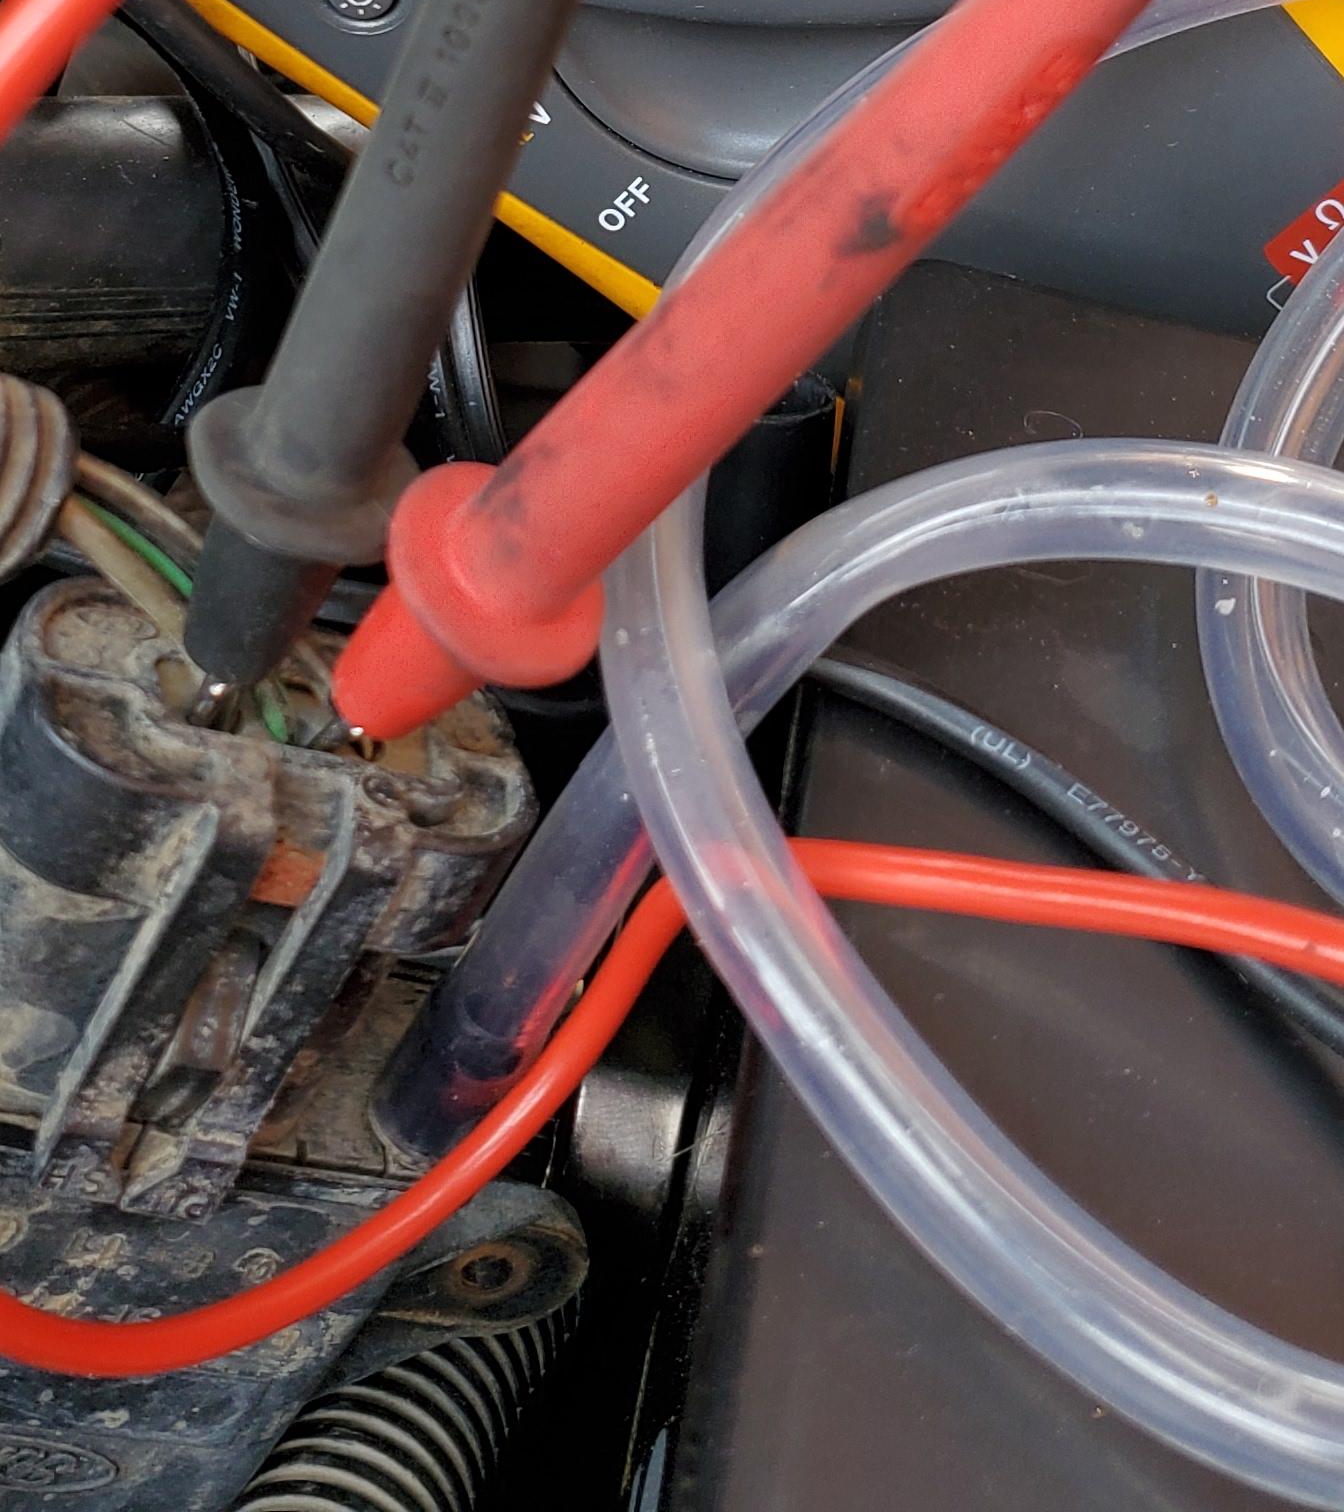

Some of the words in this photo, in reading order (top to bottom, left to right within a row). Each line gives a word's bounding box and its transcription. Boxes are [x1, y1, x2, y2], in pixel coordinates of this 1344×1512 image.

[597, 176, 652, 234] OFF
[1289, 239, 1318, 265] V
[970, 725, 1032, 770] (UL)
